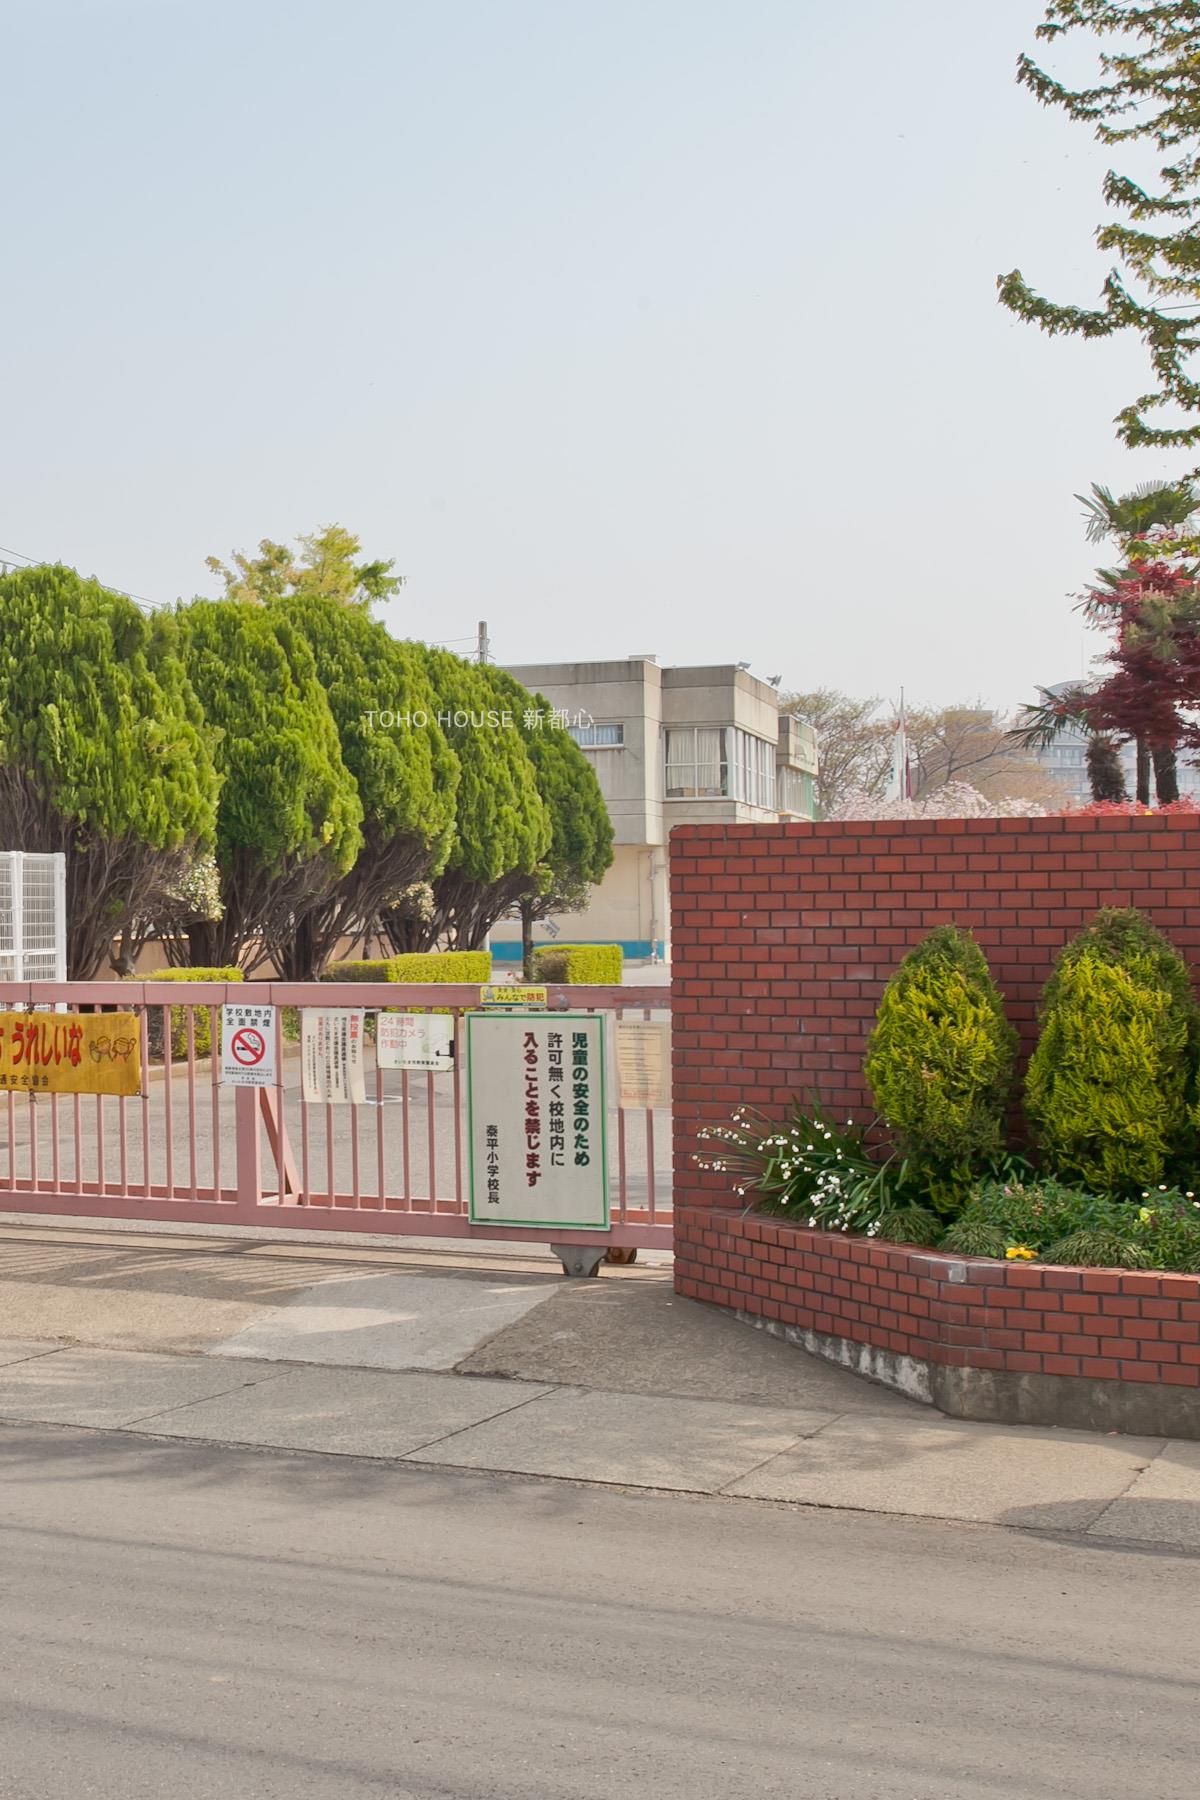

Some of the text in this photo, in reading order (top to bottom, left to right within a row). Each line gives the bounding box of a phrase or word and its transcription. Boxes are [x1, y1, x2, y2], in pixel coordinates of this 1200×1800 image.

[11, 1022, 83, 1067] うれしいな
[226, 1008, 272, 1018] 学校敷地内
[226, 1017, 271, 1028] 全面禁煙
[523, 1032, 541, 1188] 入ることを禁じます
[547, 1032, 565, 1167] 許可無く校地内に
[572, 1032, 590, 1167] 児童の安全のため
[486, 1125, 500, 1203] 泰平小学校長
